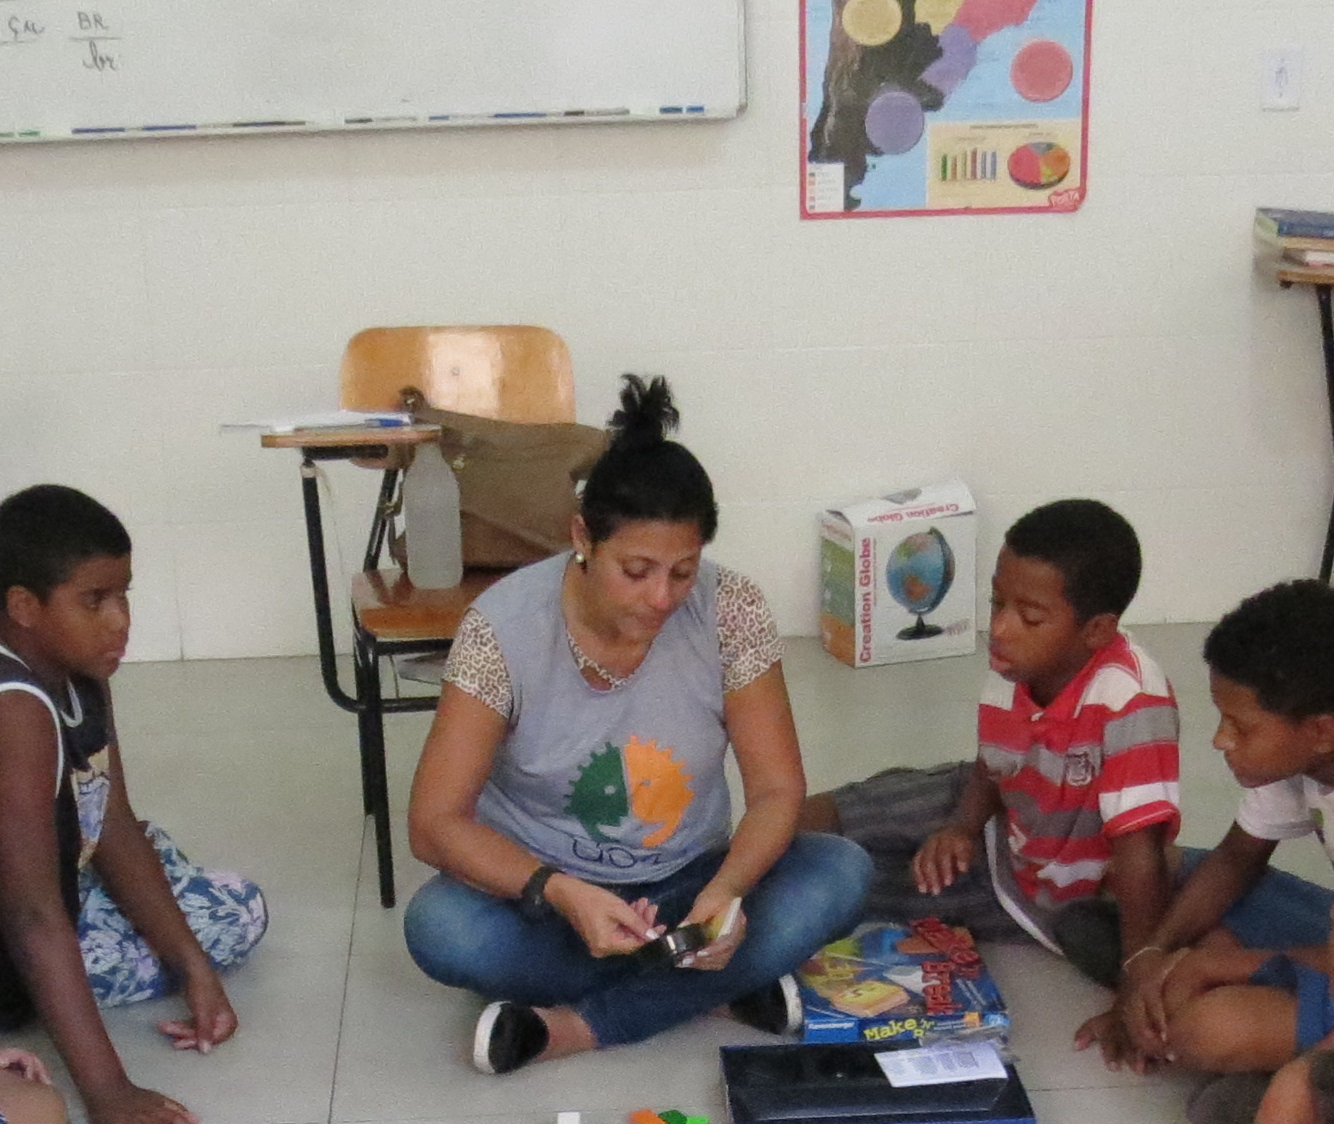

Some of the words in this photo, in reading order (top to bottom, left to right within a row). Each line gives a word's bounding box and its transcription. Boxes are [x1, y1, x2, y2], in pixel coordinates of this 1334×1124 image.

[859, 537, 872, 588] Globe
[859, 592, 872, 663] Creation
[863, 1018, 917, 1041] Make
